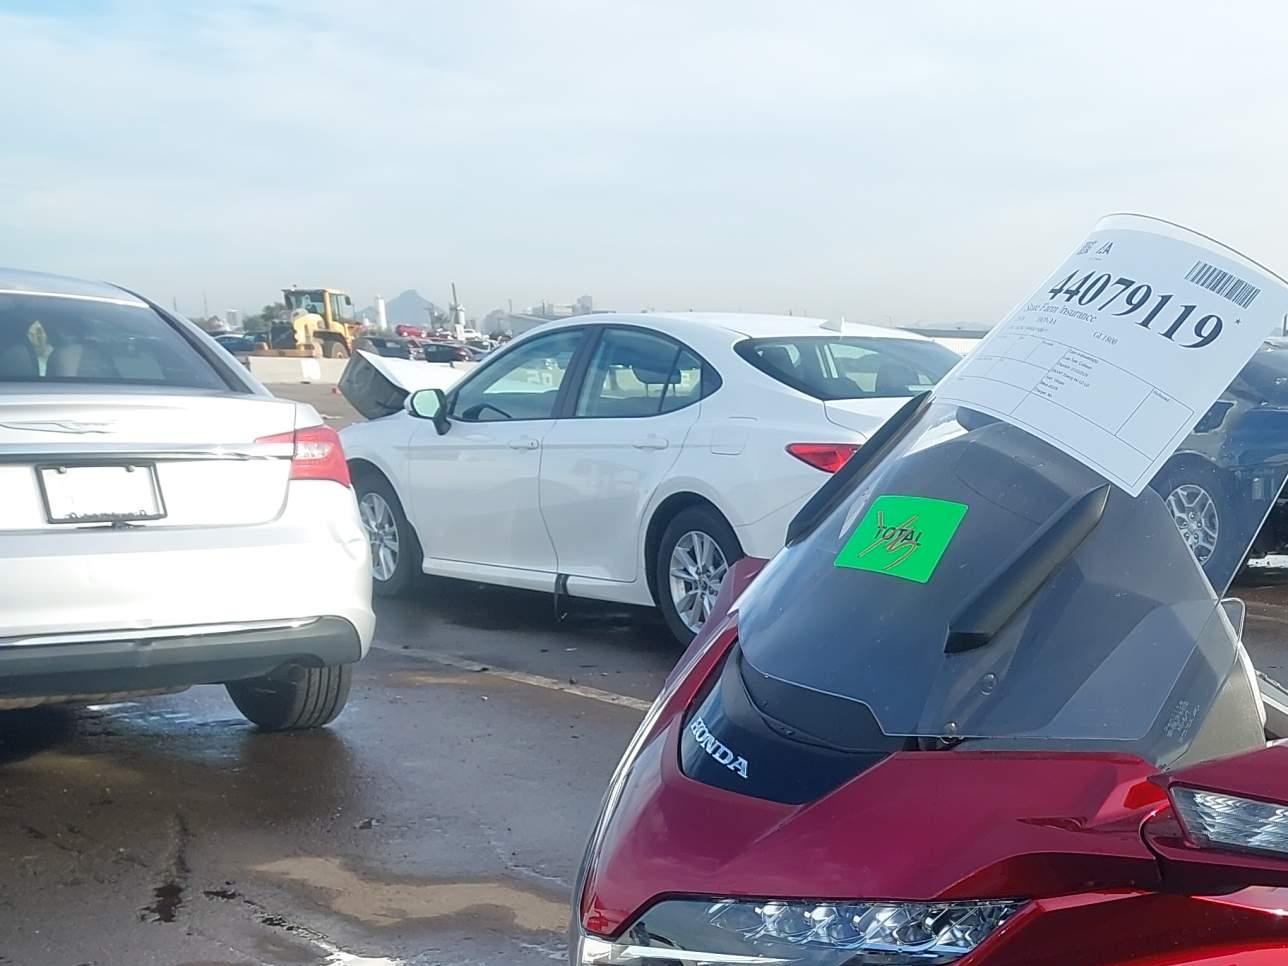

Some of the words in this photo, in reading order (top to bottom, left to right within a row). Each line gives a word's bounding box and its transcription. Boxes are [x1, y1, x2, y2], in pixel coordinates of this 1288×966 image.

[1048, 269, 1224, 349] 44079119
[1060, 305, 1097, 323] Insurance
[874, 525, 922, 546] TOTAL
[690, 717, 748, 779] HONDA
